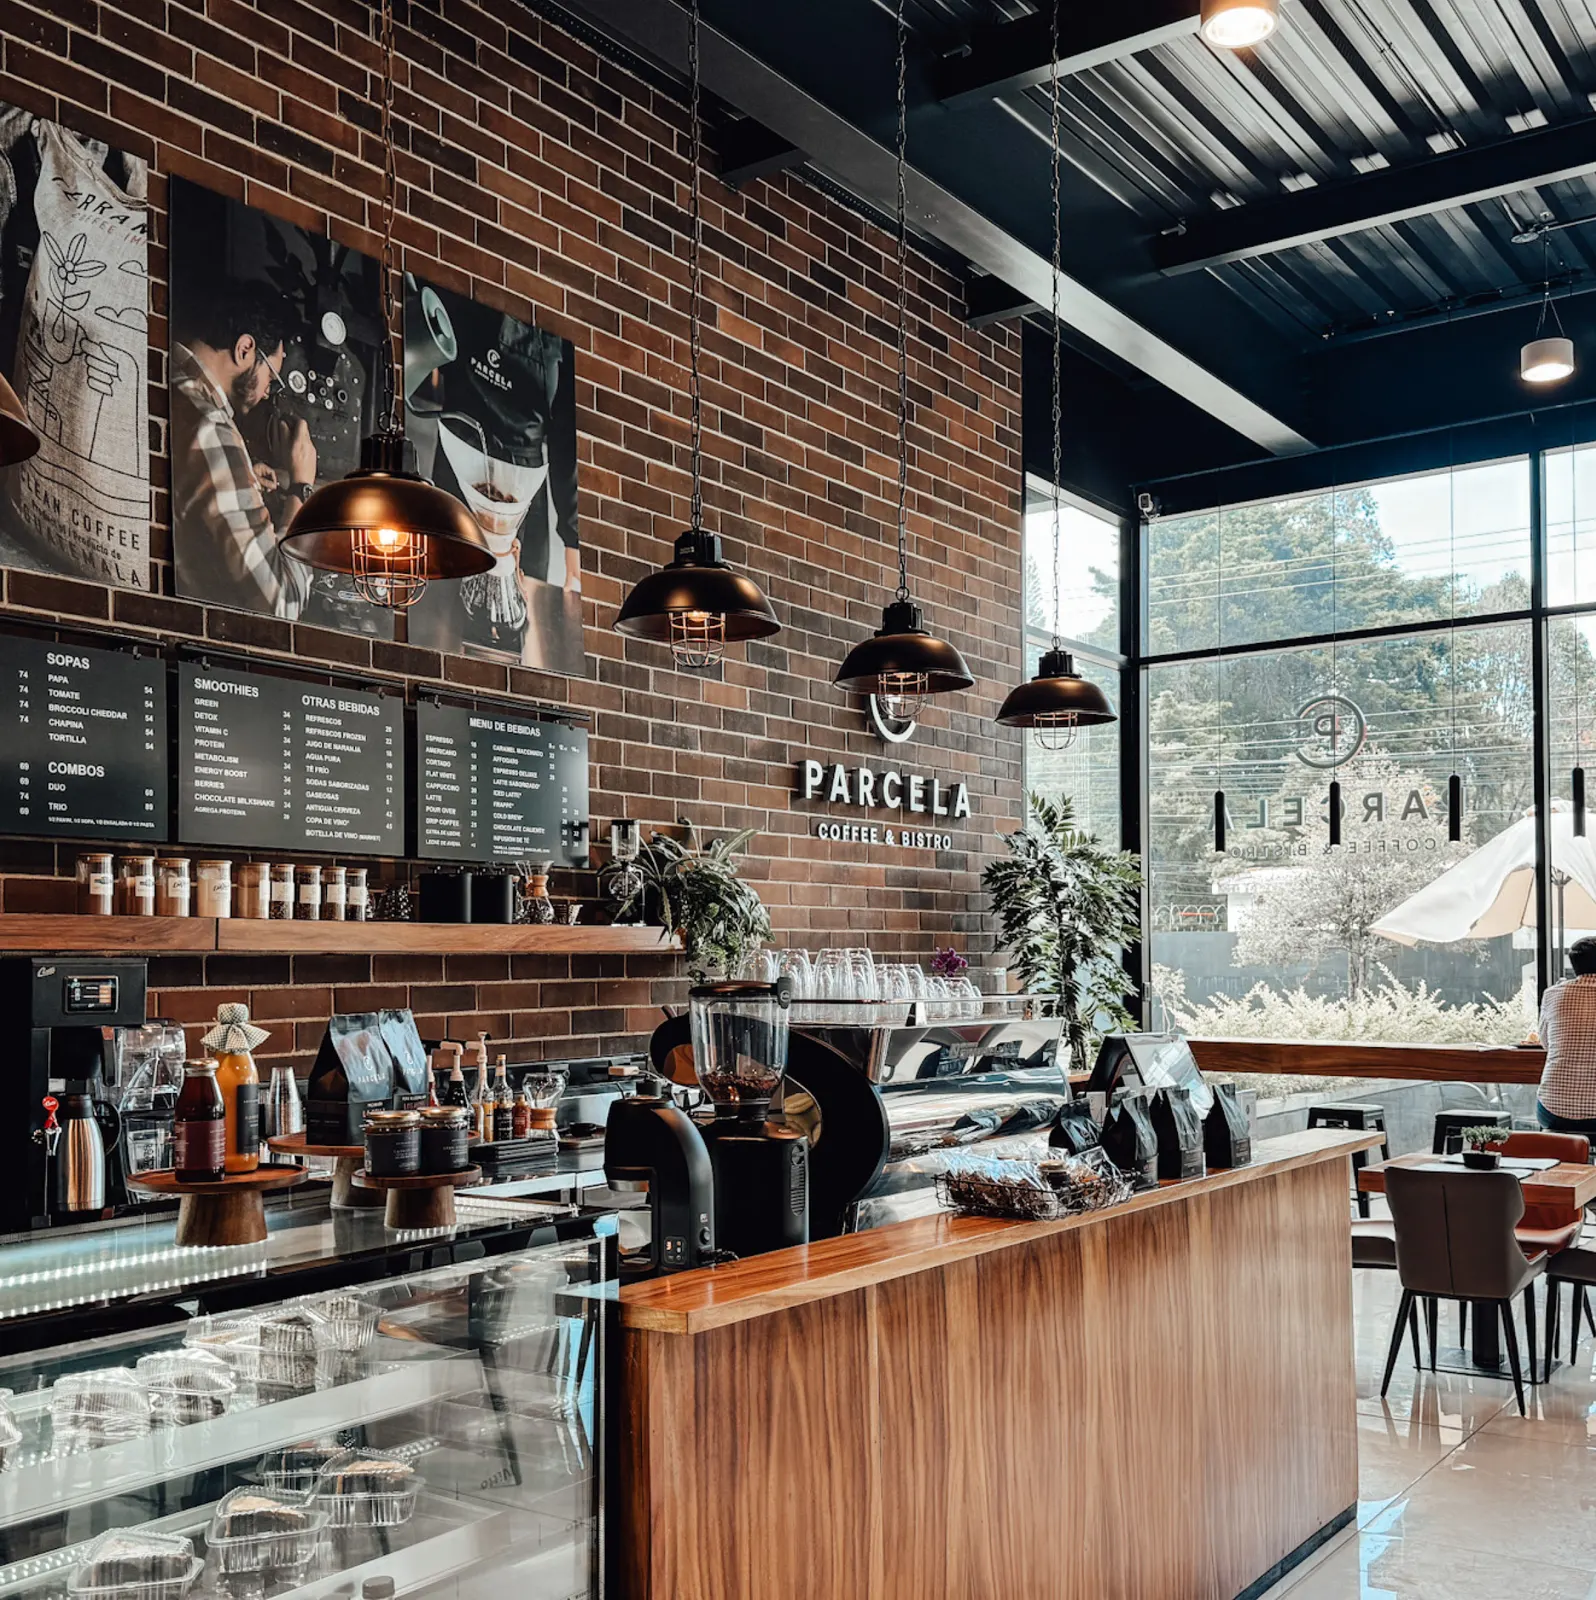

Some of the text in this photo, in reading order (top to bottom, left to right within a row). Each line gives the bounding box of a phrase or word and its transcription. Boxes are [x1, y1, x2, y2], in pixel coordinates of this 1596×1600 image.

[470, 357, 512, 389] PARCELA
[72, 508, 140, 550] COFFEE
[47, 652, 90, 669] SOPAS
[48, 674, 69, 684] PAPA
[194, 677, 259, 697] SMOOTHIES
[48, 689, 80, 700] TOMATE
[194, 698, 218, 708] GREEN
[302, 695, 380, 716] OTRAS BEBIDAS
[48, 704, 89, 715] BROCCOLI
[91, 709, 127, 720] CHEDDAR
[194, 712, 218, 721] DETOX
[48, 718, 83, 729] CHAPINA
[305, 714, 342, 726] REFRESCOS
[194, 725, 221, 735] VITAMIN
[470, 717, 541, 737] MENU DE BEBIDAS
[49, 733, 86, 744] TORTILLA
[305, 727, 342, 738] REFRESCOS
[343, 732, 367, 742] FROZEN
[426, 735, 453, 744] ESPRESSO
[194, 739, 224, 749] PROTEIN
[306, 740, 361, 753] JUGO DE NARANJA
[426, 747, 457, 756] AMERICANO
[194, 753, 239, 764] METABOLISM
[306, 753, 341, 763] AGUA PURA
[426, 759, 451, 768] CORTADO
[48, 762, 105, 777] COMBOS
[194, 766, 222, 776] ENERGY
[224, 769, 248, 778] BOOST
[48, 783, 66, 791] DUO
[194, 780, 224, 789] BERRIES
[306, 778, 327, 787] SODAS
[328, 780, 369, 791] SABORIZADAS
[426, 782, 460, 792] CAPPUCCINO
[806, 760, 971, 818] PARCELA
[20, 792, 29, 800] 74
[194, 793, 236, 804] CHOCOLATE
[237, 797, 275, 808] MILKSHAKE
[306, 791, 339, 801] GASEOSAS
[48, 802, 67, 811] TRIO
[306, 804, 333, 813] ANTIGUA
[334, 806, 361, 815] CERVEZA
[306, 817, 323, 825] COPA
[306, 829, 333, 838] BOTELLA
[818, 823, 951, 850] COFFEE & BISTRO
